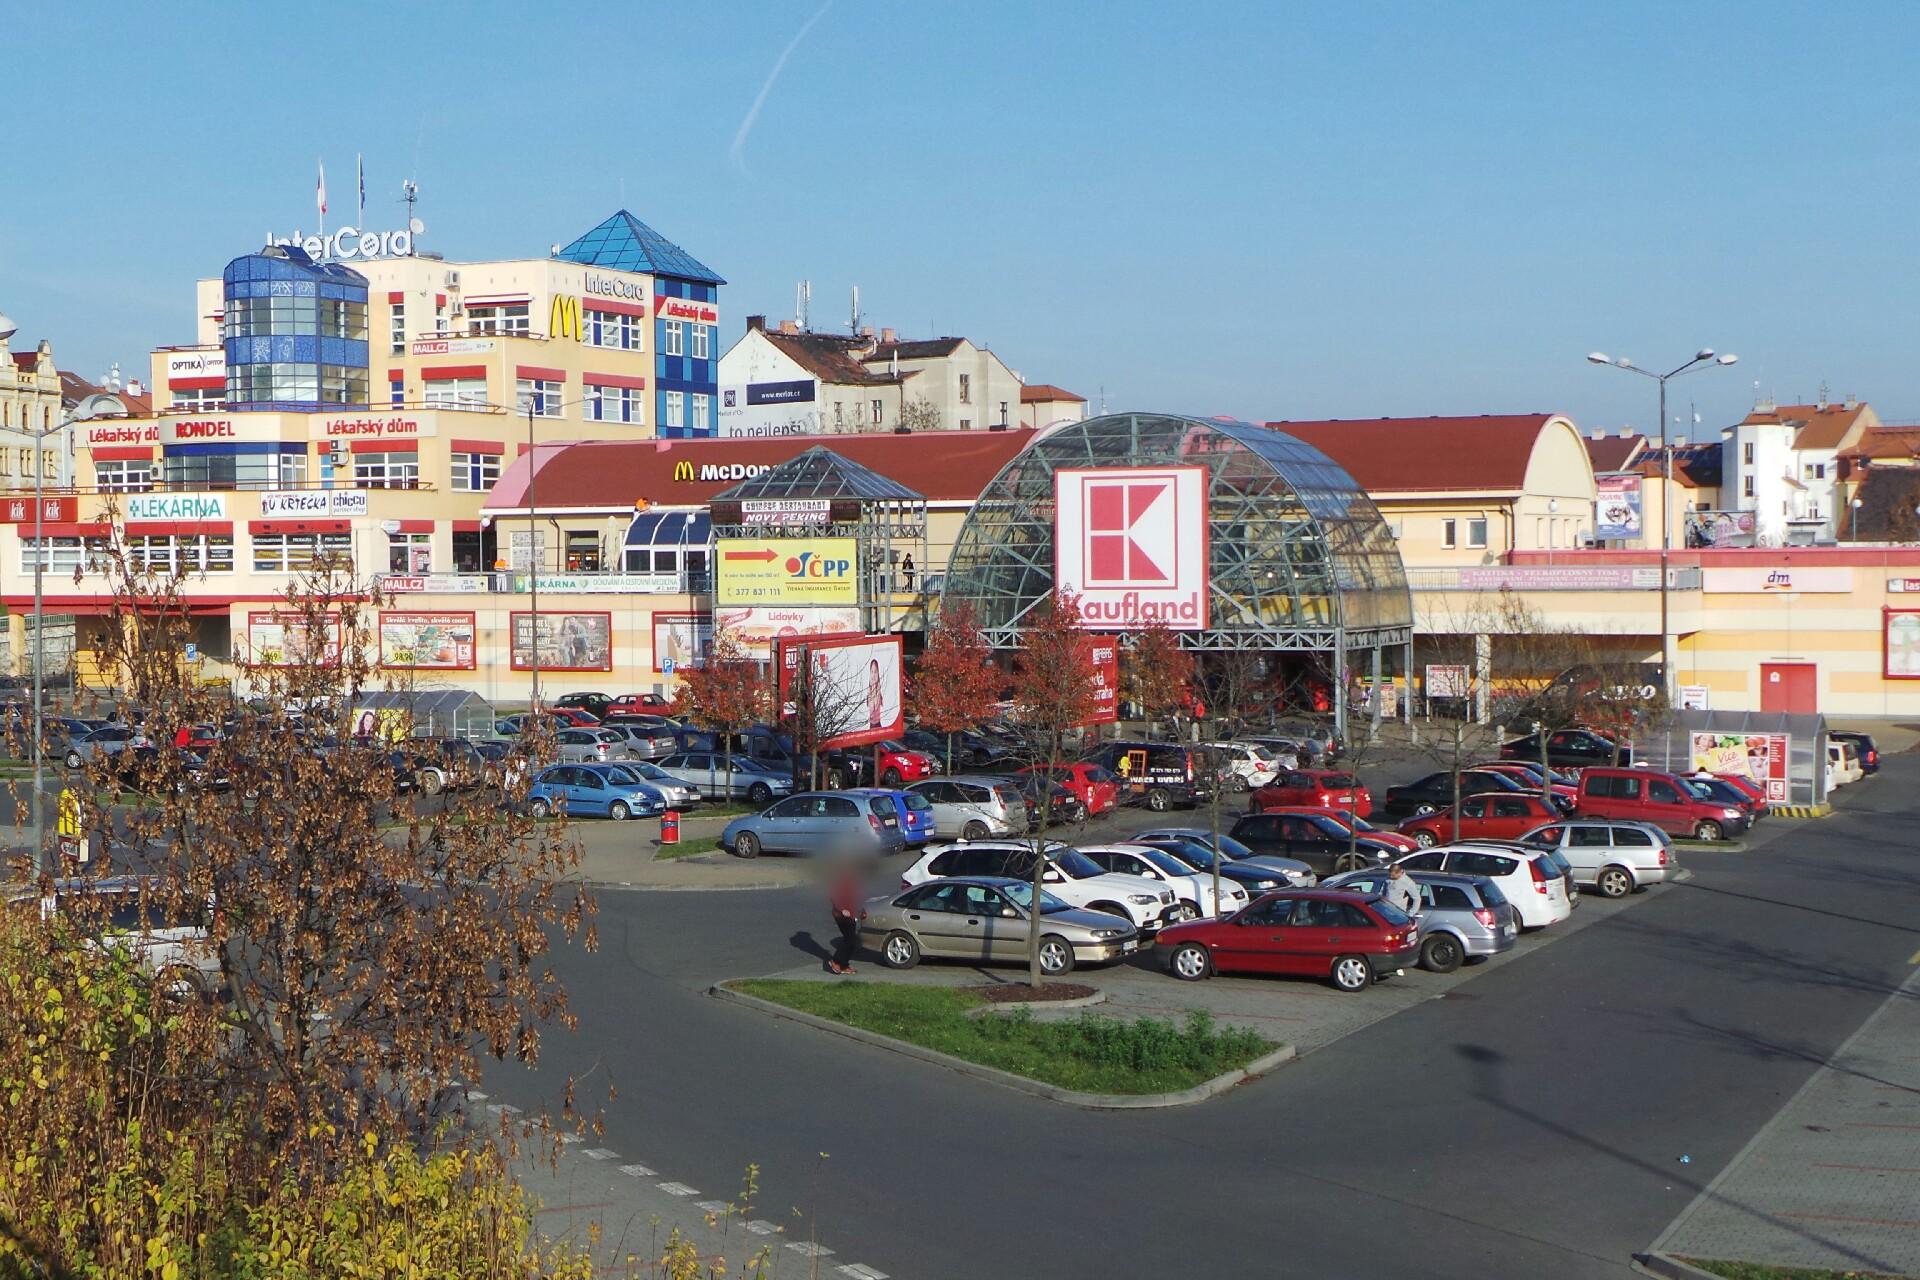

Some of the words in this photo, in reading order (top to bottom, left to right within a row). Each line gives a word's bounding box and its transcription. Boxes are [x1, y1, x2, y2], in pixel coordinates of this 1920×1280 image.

[585, 271, 644, 300] InterCora
[413, 343, 447, 353] MALL.CZ
[172, 360, 202, 370] OPTIKA
[89, 427, 142, 444] Lékařský
[145, 426, 160, 440] dů
[175, 421, 236, 438] RONDEL
[326, 418, 383, 436] Lékařský
[387, 417, 418, 433] dům
[729, 425, 743, 437] to
[11, 502, 24, 519] kik
[46, 501, 60, 518] kik
[141, 496, 222, 518] LÉKÁRNA
[281, 494, 327, 511] KRTEČKA
[779, 501, 827, 510] RESTAURANT
[746, 511, 778, 522] NOVÝ
[782, 512, 827, 521] PEKING
[809, 554, 850, 578] ČPP
[384, 579, 423, 590] MALL.CZ
[1767, 570, 1790, 583] dm
[1062, 591, 1198, 620] Kaufland
[768, 611, 805, 622] Lidovky
